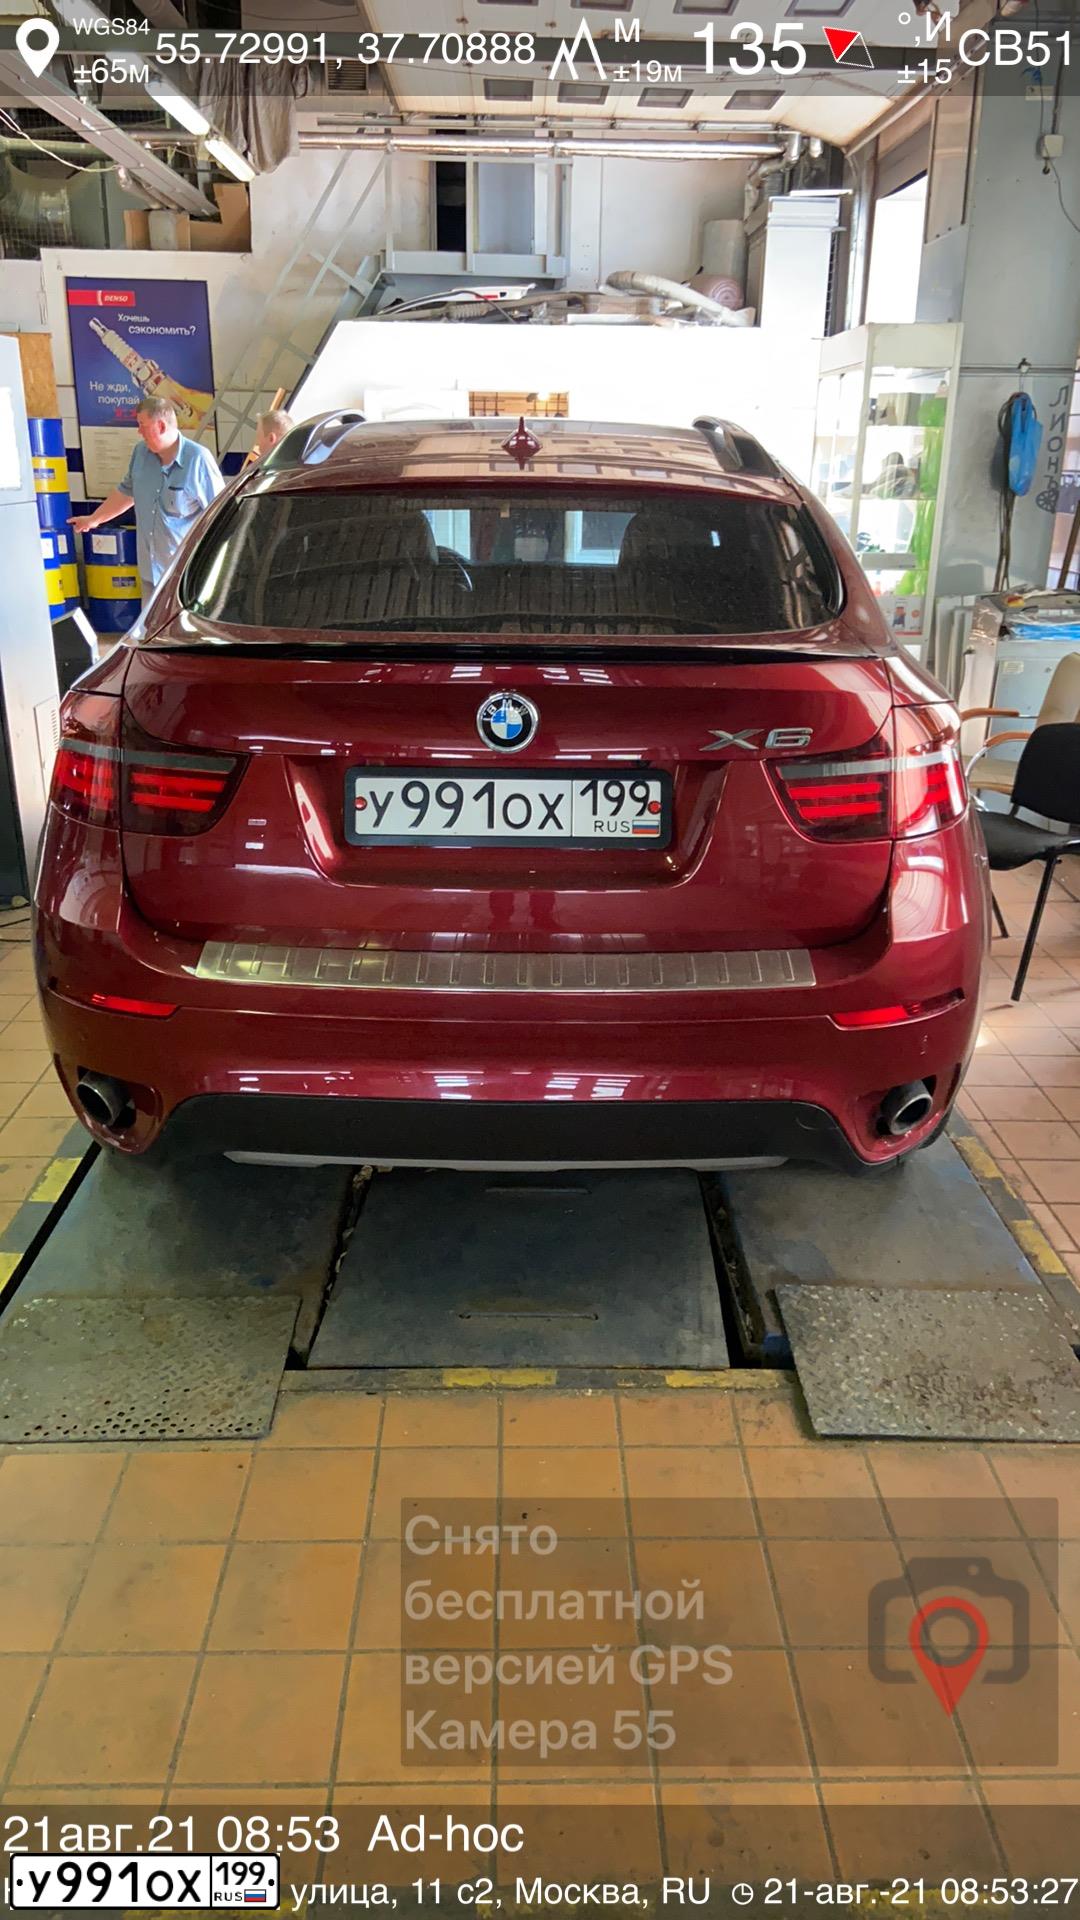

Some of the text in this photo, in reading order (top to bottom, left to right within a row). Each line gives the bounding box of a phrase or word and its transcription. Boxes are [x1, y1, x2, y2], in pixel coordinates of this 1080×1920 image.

[117, 313, 150, 323] Хочешь
[128, 325, 196, 336] сэкономить?
[89, 380, 131, 393] Не жди,
[97, 395, 140, 407] покупай
[486, 698, 529, 717] BMW
[700, 727, 814, 752] X6
[579, 779, 651, 817] 199
[594, 820, 631, 834] RUS
